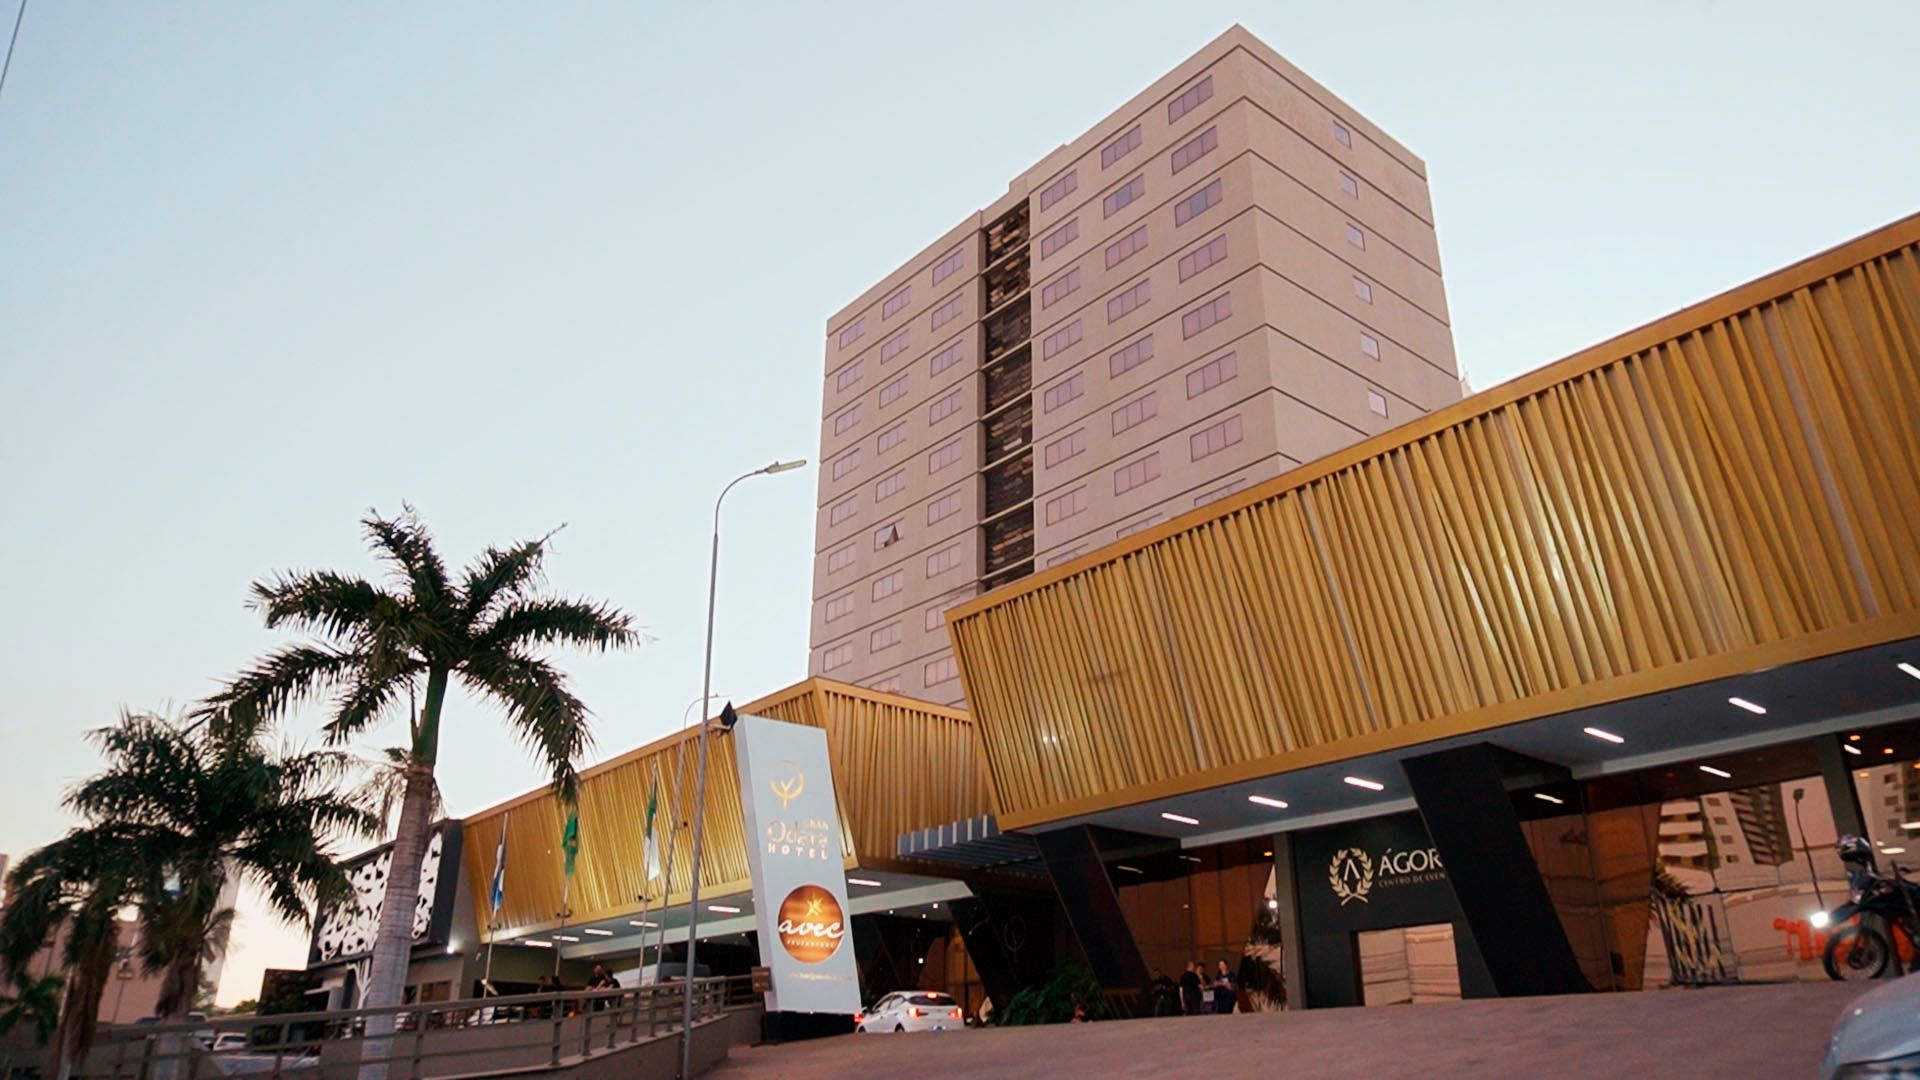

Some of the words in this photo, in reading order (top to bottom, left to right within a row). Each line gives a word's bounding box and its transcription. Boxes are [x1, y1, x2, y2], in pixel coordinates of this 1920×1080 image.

[767, 843, 829, 860] HOTEL
[1378, 847, 1443, 877] ÁGOR
[1412, 875, 1424, 883] DE
[778, 919, 845, 939] avec
